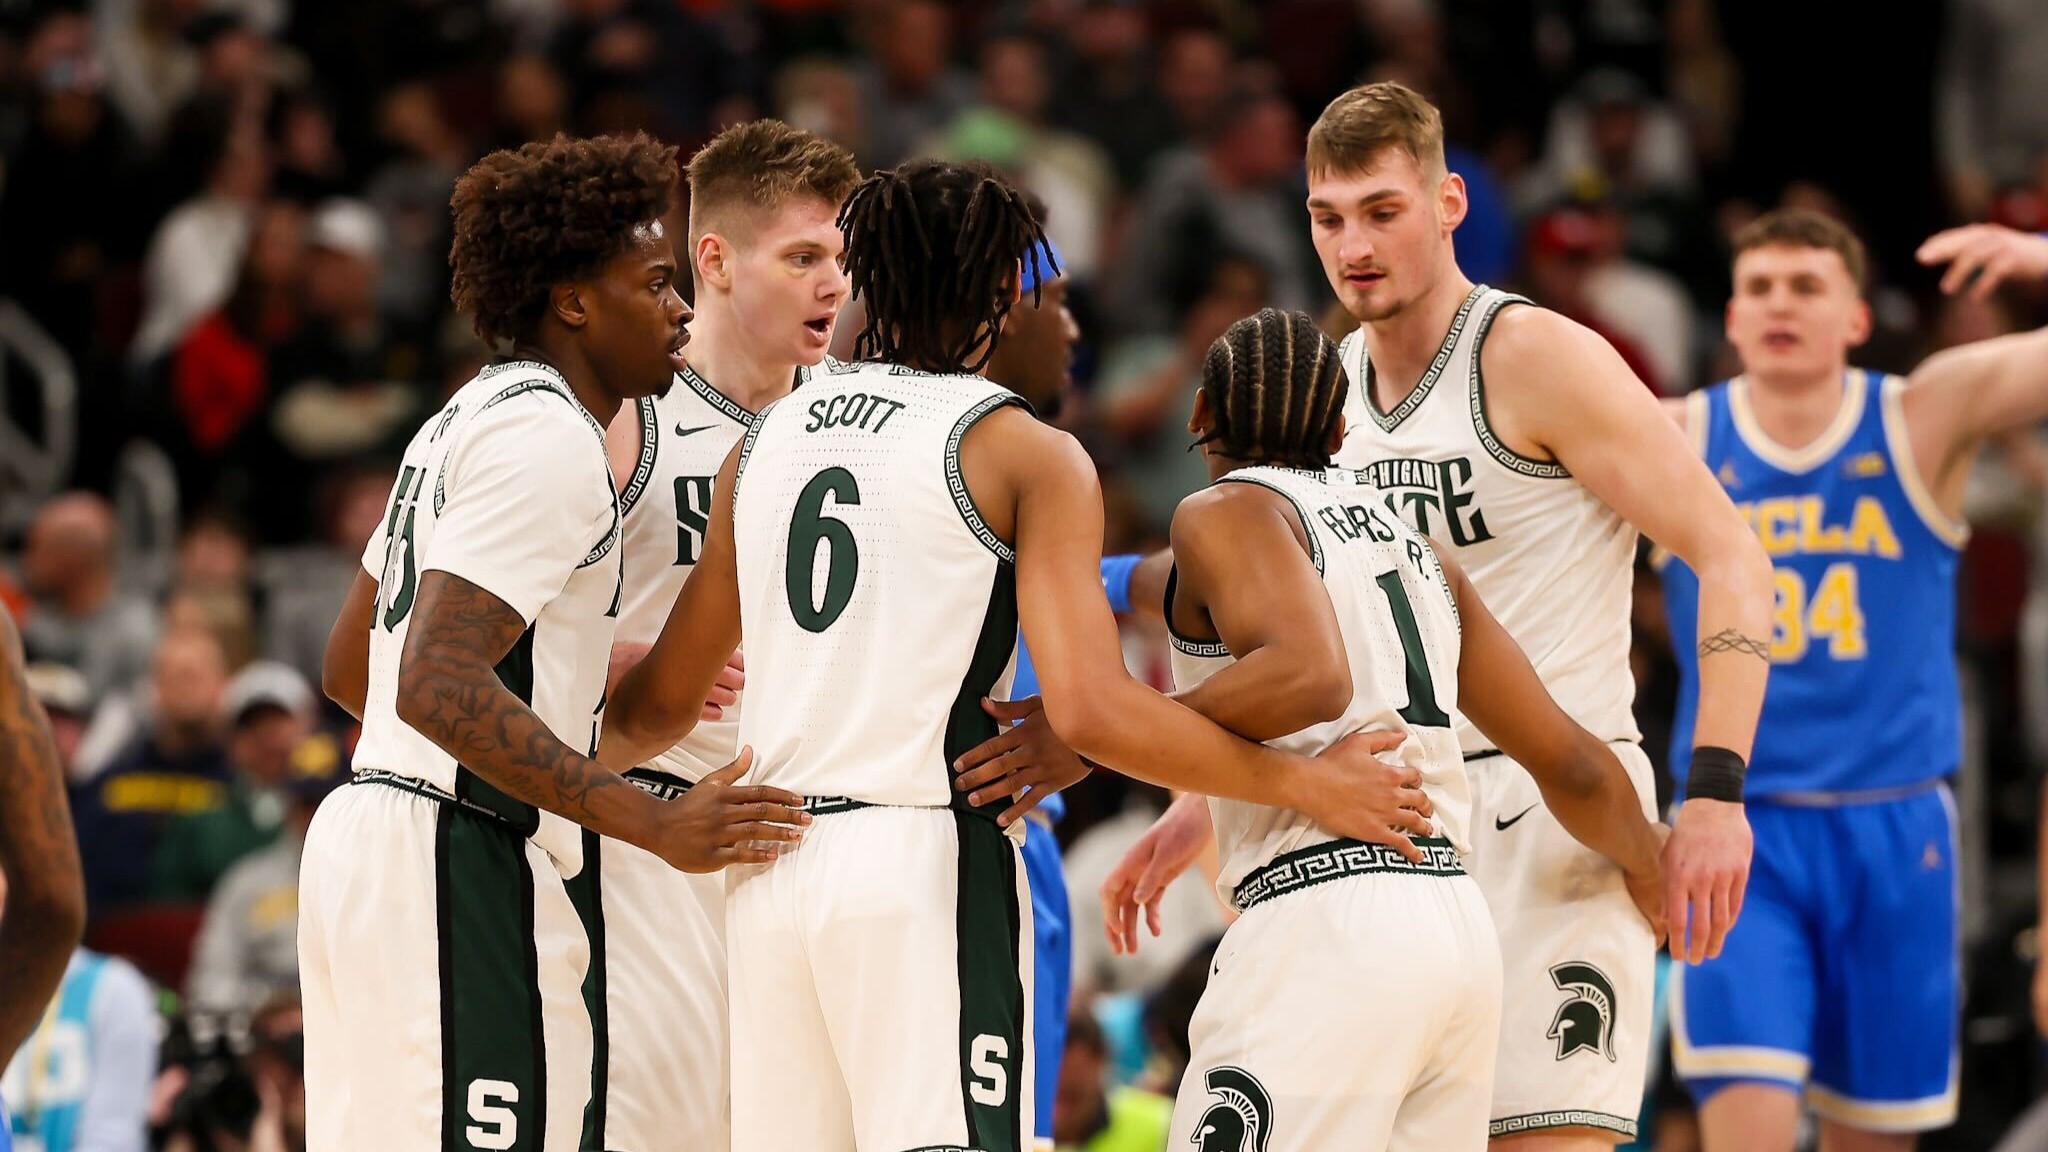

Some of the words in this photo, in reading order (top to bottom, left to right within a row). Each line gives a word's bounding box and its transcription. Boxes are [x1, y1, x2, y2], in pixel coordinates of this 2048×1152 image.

[805, 393, 906, 434] SCOTT
[1367, 459, 1437, 490] CHIGAN
[785, 466, 861, 633] 6
[1735, 493, 1904, 560] CLA
[1375, 569, 1451, 728] 1
[968, 1033, 1009, 1108] S
[465, 1078, 519, 1151] S
